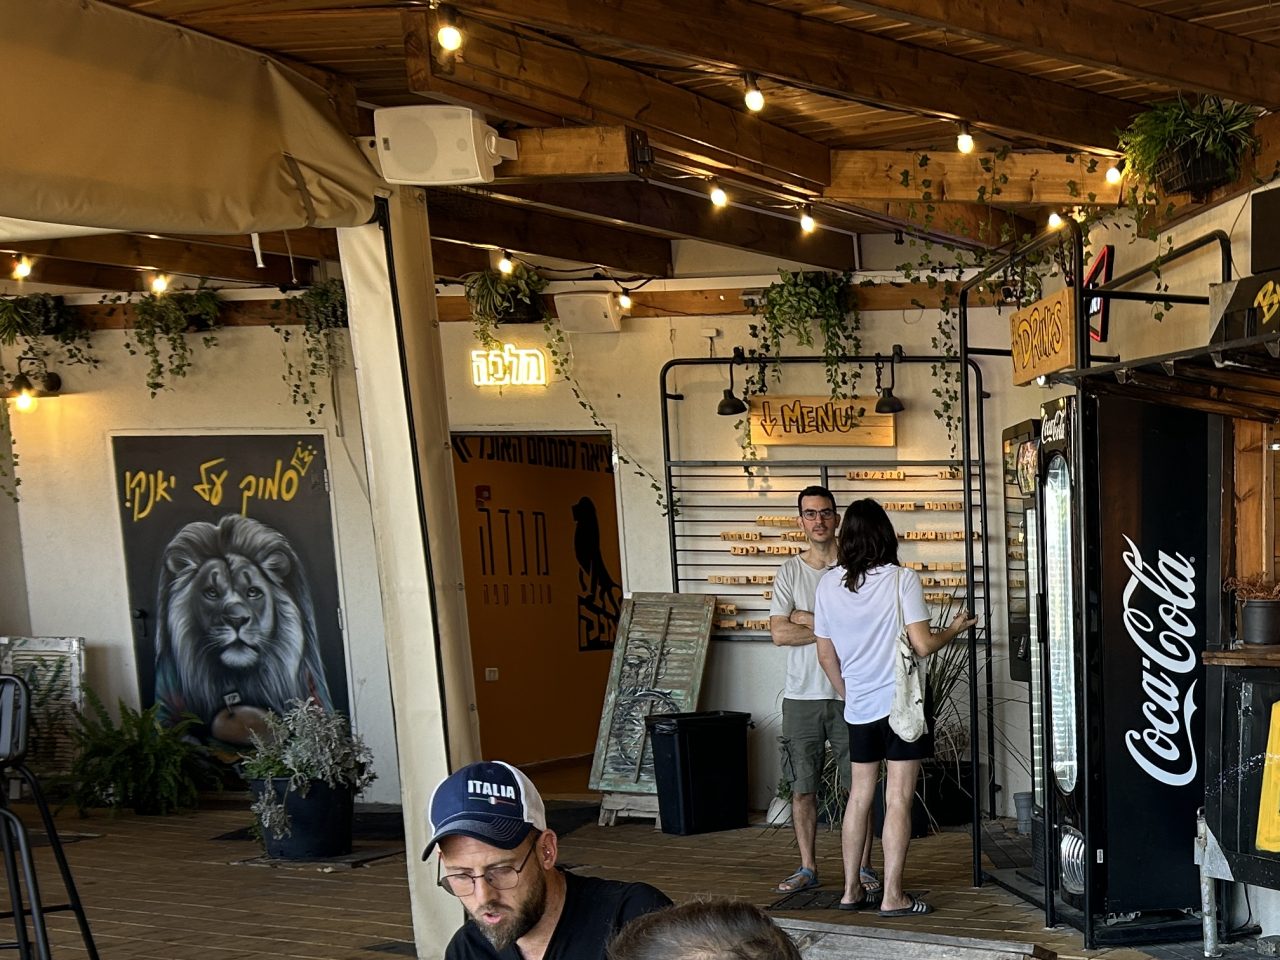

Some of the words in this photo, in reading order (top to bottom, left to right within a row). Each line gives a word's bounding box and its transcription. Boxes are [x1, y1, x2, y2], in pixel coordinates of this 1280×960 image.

[1018, 300, 1063, 369] DRINKS
[781, 400, 853, 434] MENU
[193, 457, 229, 506] על
[1122, 533, 1198, 787] Coca-Cola
[467, 779, 516, 800] ITALIA
